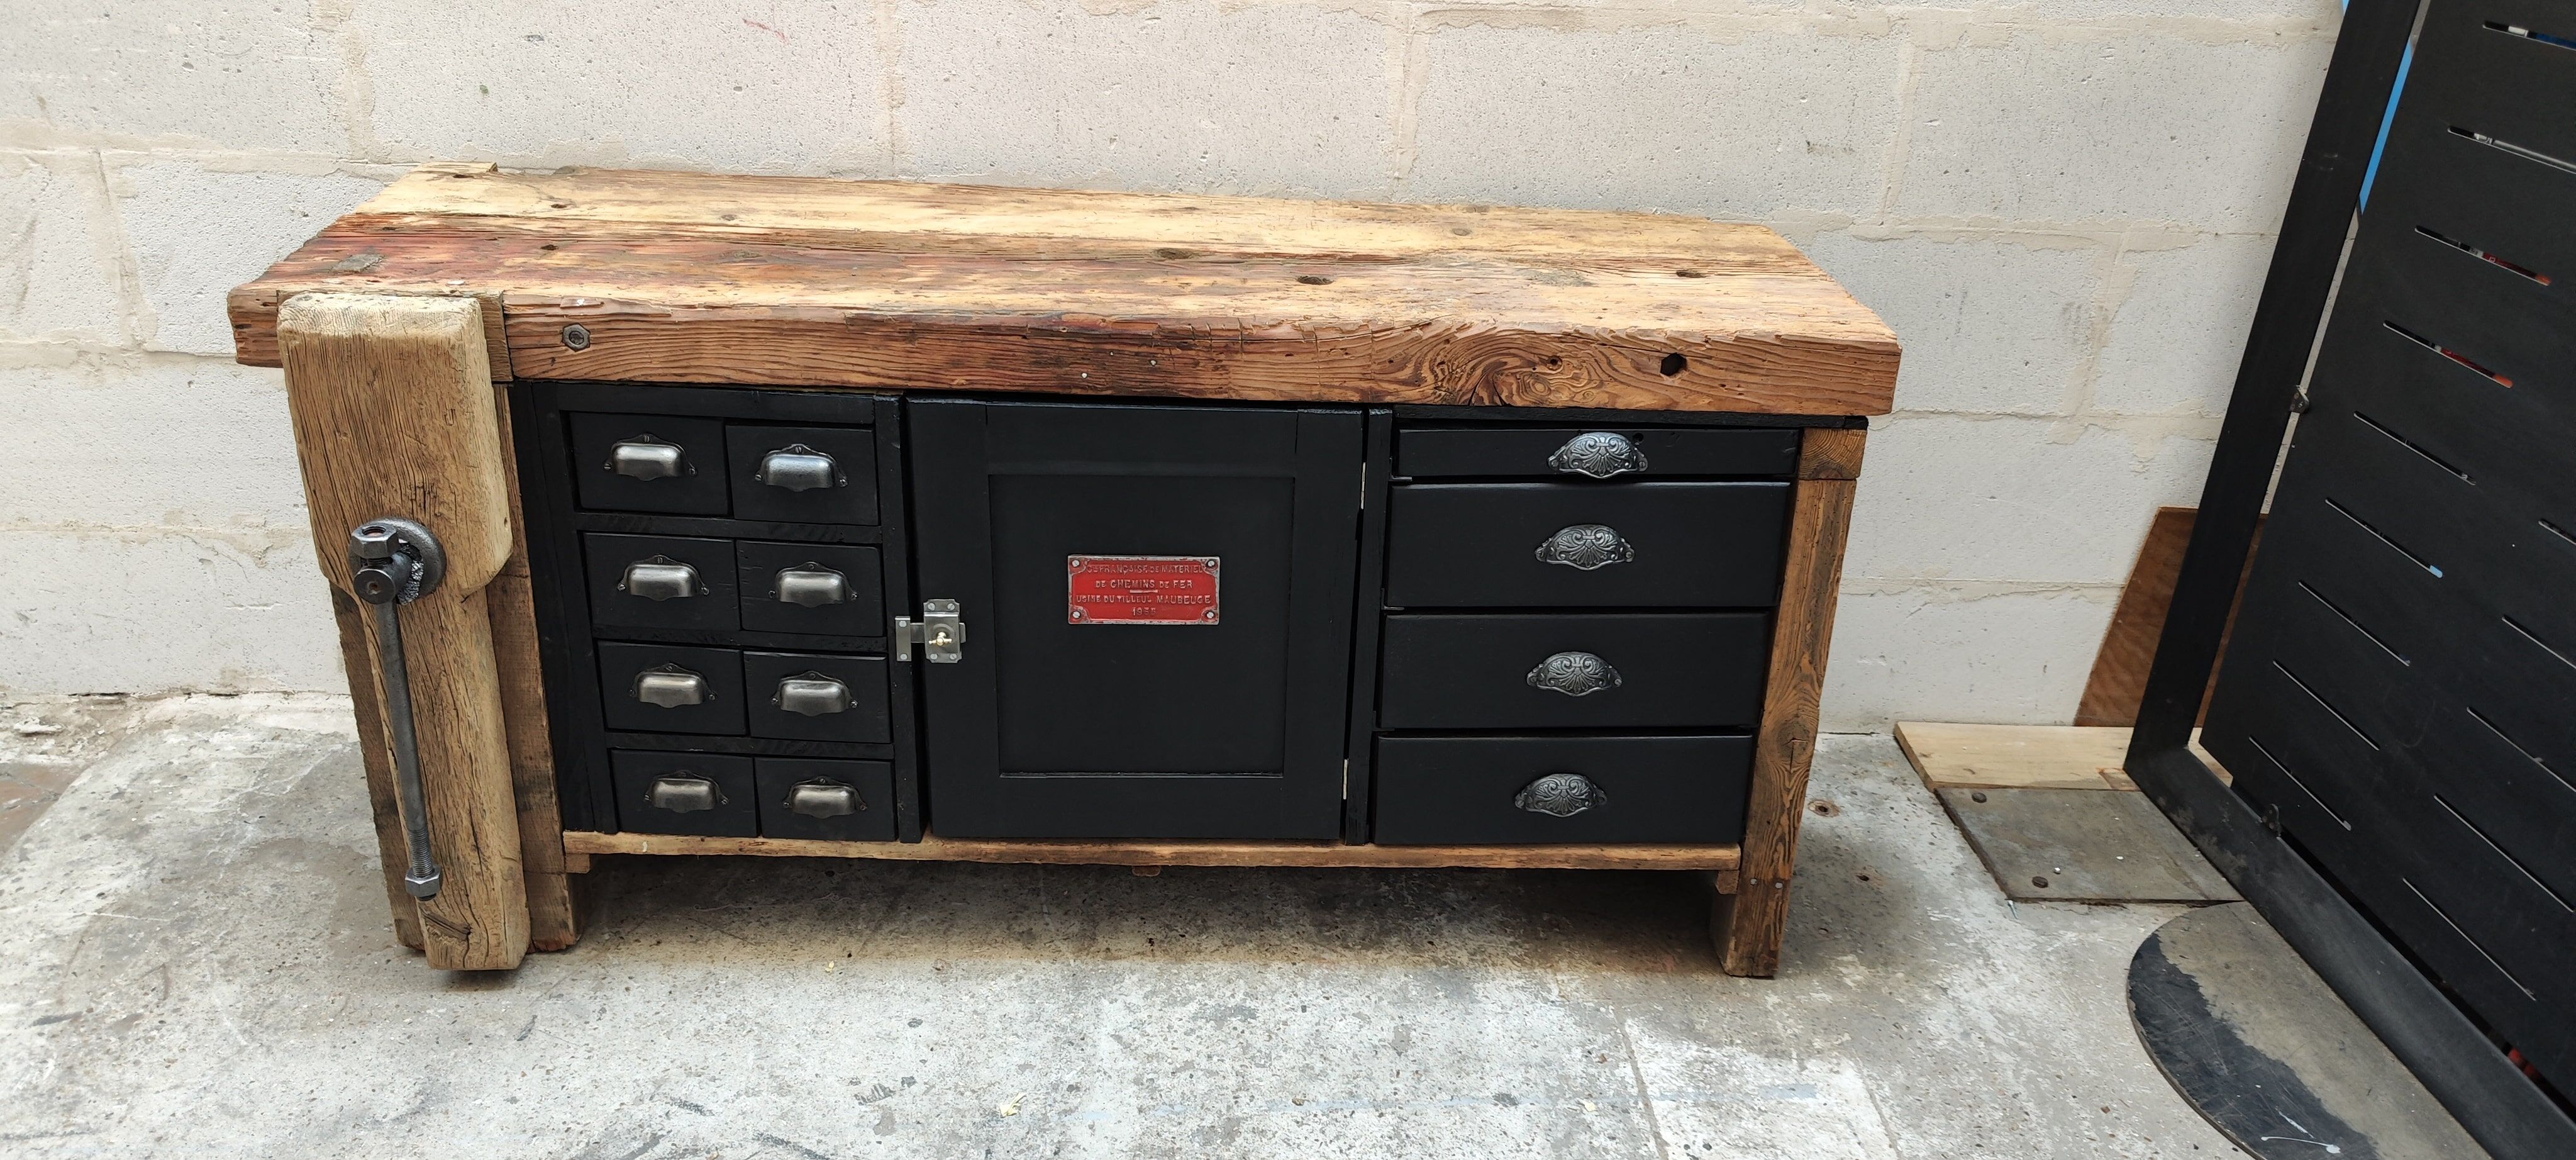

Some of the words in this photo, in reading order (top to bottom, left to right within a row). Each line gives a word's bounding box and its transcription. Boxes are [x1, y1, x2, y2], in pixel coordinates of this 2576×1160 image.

[1096, 580, 1106, 588] DE
[1110, 579, 1155, 589] CHEMINS
[1159, 580, 1169, 589] DE
[1173, 579, 1193, 589] FER
[1104, 595, 1114, 603] DU
[1157, 594, 1211, 605] MAUBEUGE
